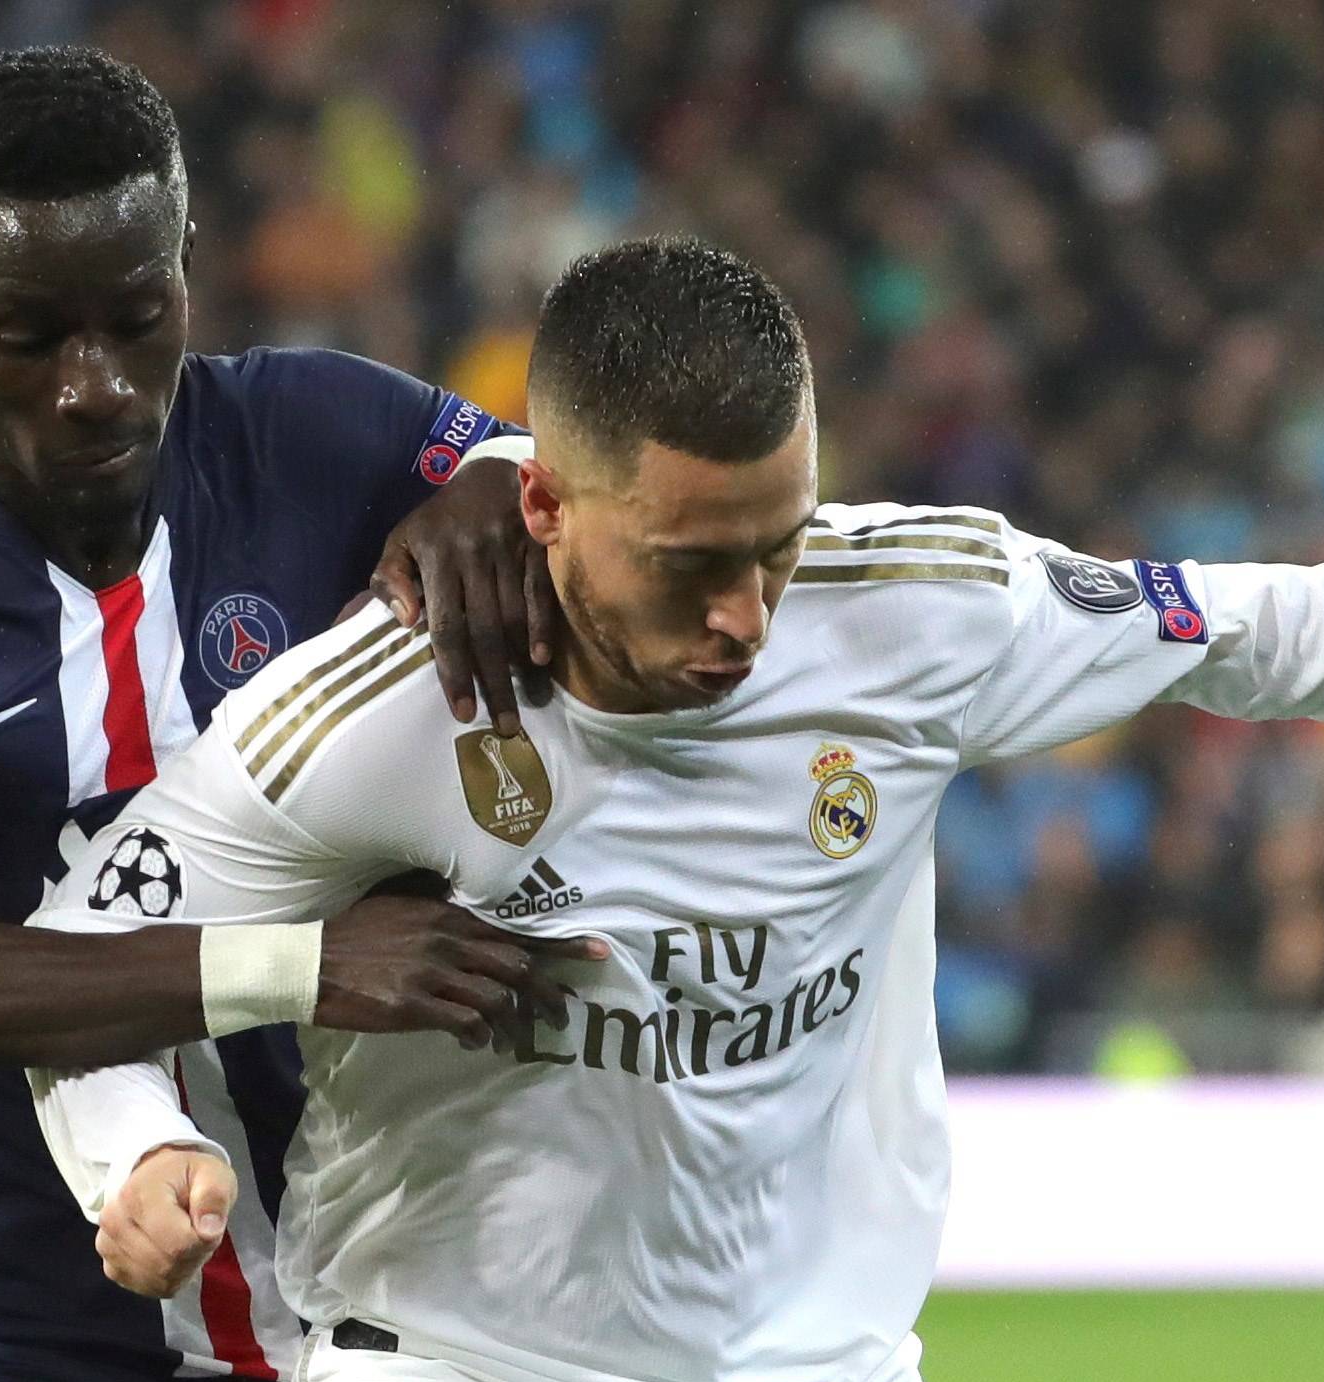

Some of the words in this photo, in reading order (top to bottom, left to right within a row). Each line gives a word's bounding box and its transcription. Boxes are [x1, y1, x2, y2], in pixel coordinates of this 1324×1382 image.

[205, 598, 259, 636] PARIS
[494, 797, 535, 820] FIFA
[508, 820, 533, 835] 2018
[494, 885, 584, 920] adidas
[650, 921, 768, 990] Fly
